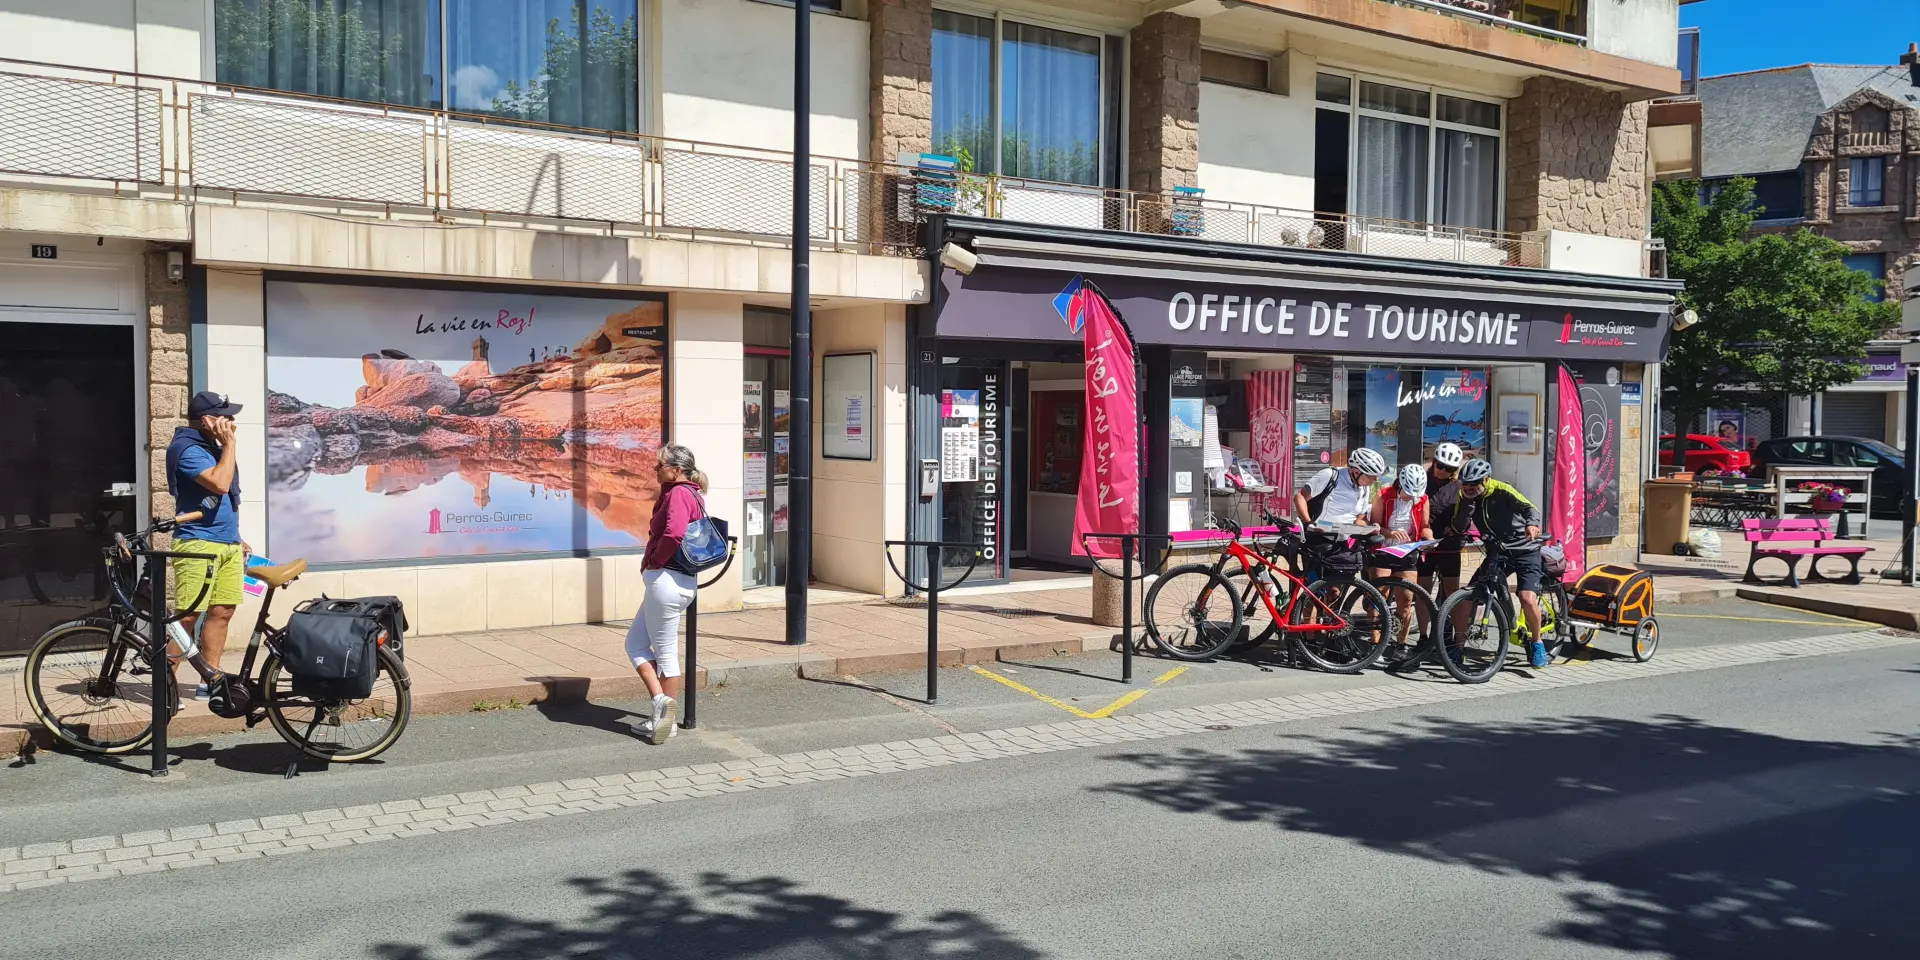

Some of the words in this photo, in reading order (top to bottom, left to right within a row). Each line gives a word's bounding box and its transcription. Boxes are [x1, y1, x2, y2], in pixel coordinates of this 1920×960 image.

[36, 246, 52, 258] 19
[416, 313, 435, 334] La
[441, 316, 466, 333] vie
[470, 318, 492, 331] en
[496, 307, 535, 336] Roz!
[1168, 291, 1297, 335] OFFICE
[1308, 301, 1352, 337] DE
[1365, 304, 1521, 345] TOURISME
[1574, 319, 1636, 335] Perros-Guirec
[924, 352, 931, 361] 21
[1397, 380, 1413, 407] La
[1415, 381, 1435, 403] vie
[1439, 383, 1456, 398] en
[1460, 364, 1491, 401] Roz!
[984, 374, 997, 466] TOURISME
[1602, 418, 1613, 455] welcome
[984, 472, 996, 494] DE
[446, 511, 533, 523] Perros-Guirec
[984, 500, 996, 559] OFFICE
